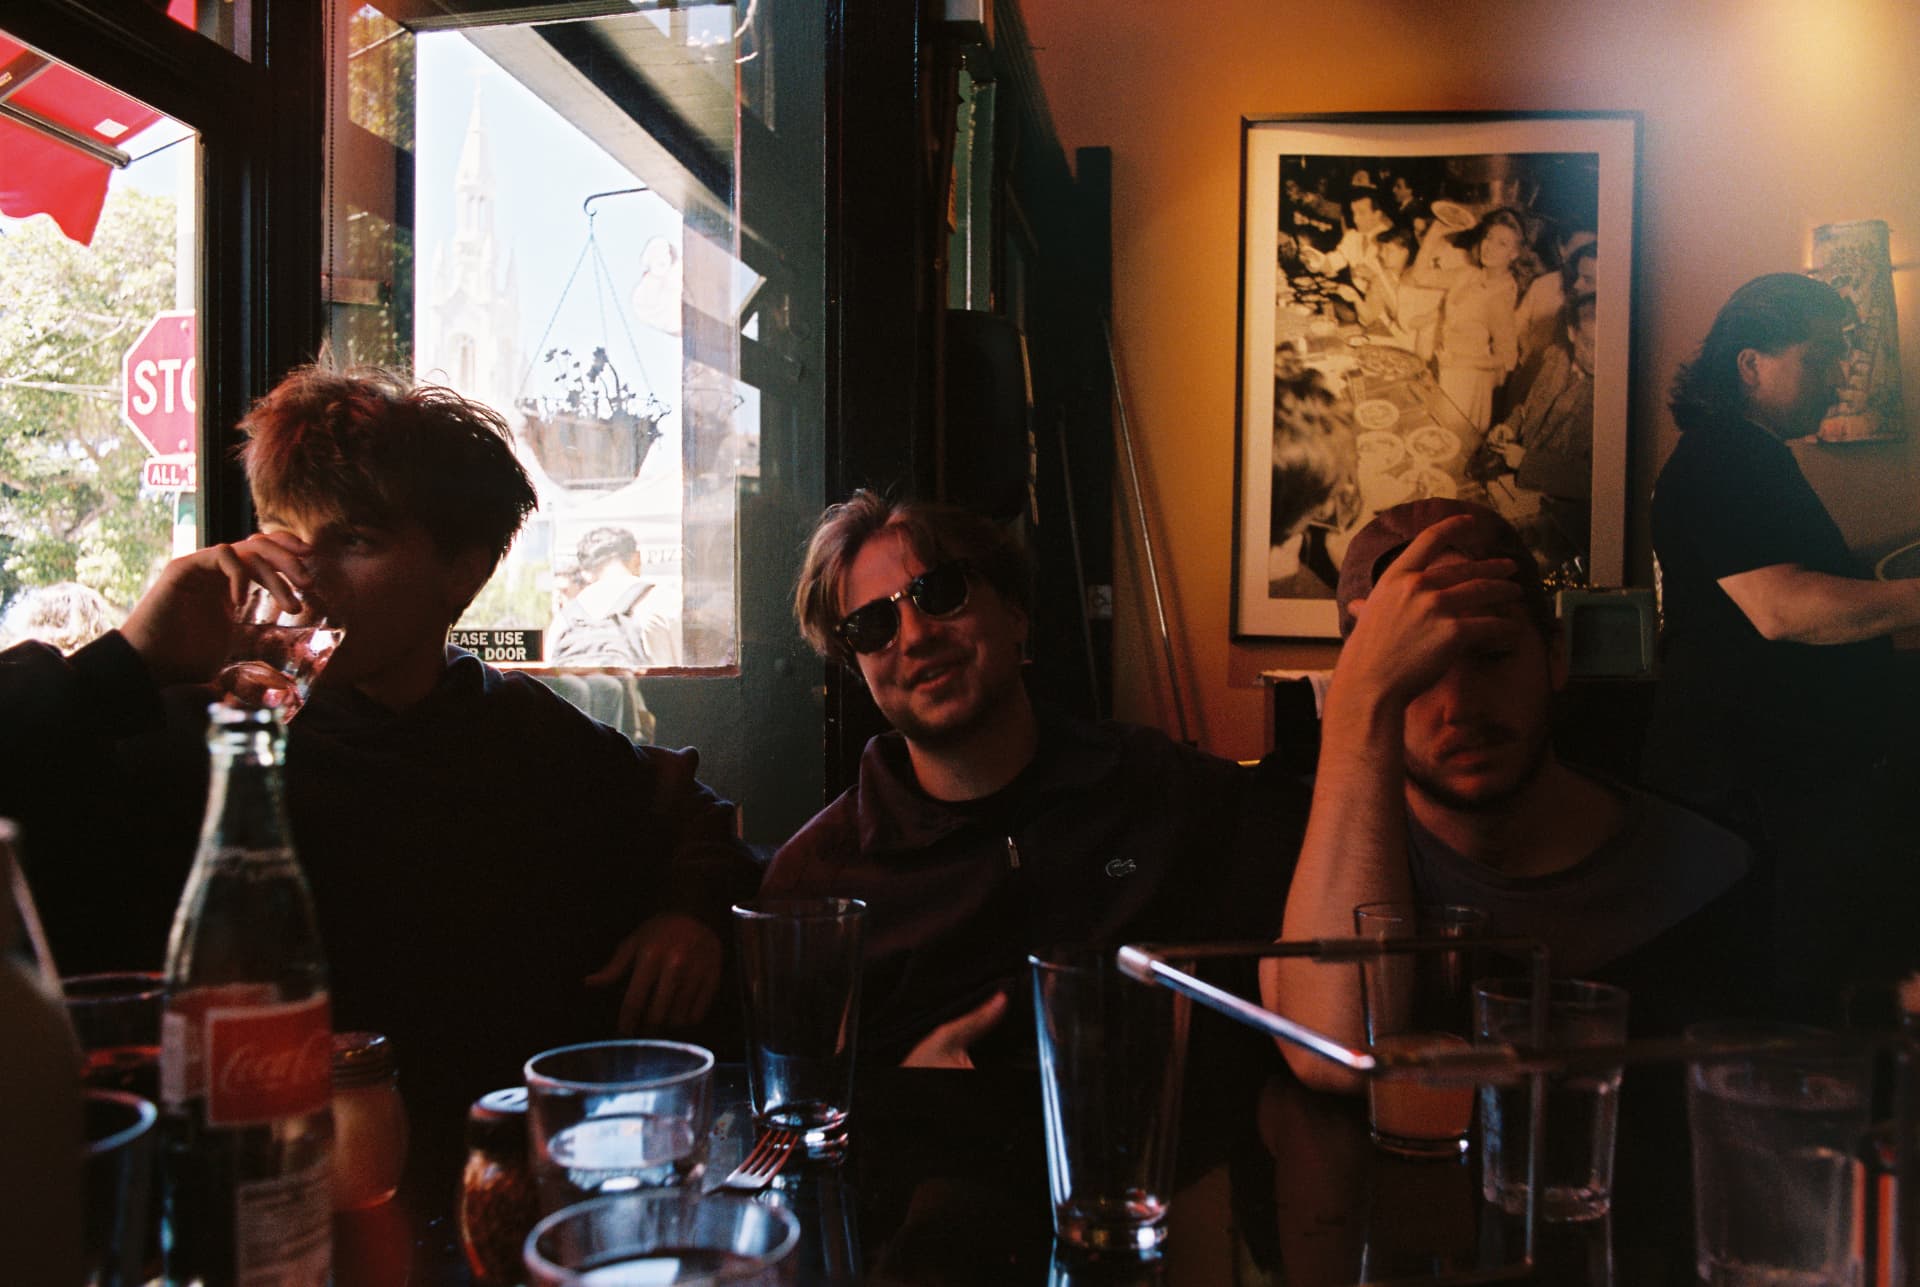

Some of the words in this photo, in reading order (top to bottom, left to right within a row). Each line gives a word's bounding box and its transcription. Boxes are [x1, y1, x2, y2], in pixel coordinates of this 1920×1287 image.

[132, 357, 196, 415] STO
[151, 465, 180, 485] ALL
[647, 547, 677, 562] PIZ
[450, 632, 489, 646] EASE
[494, 632, 525, 646] USE
[485, 647, 527, 661] DOOR
